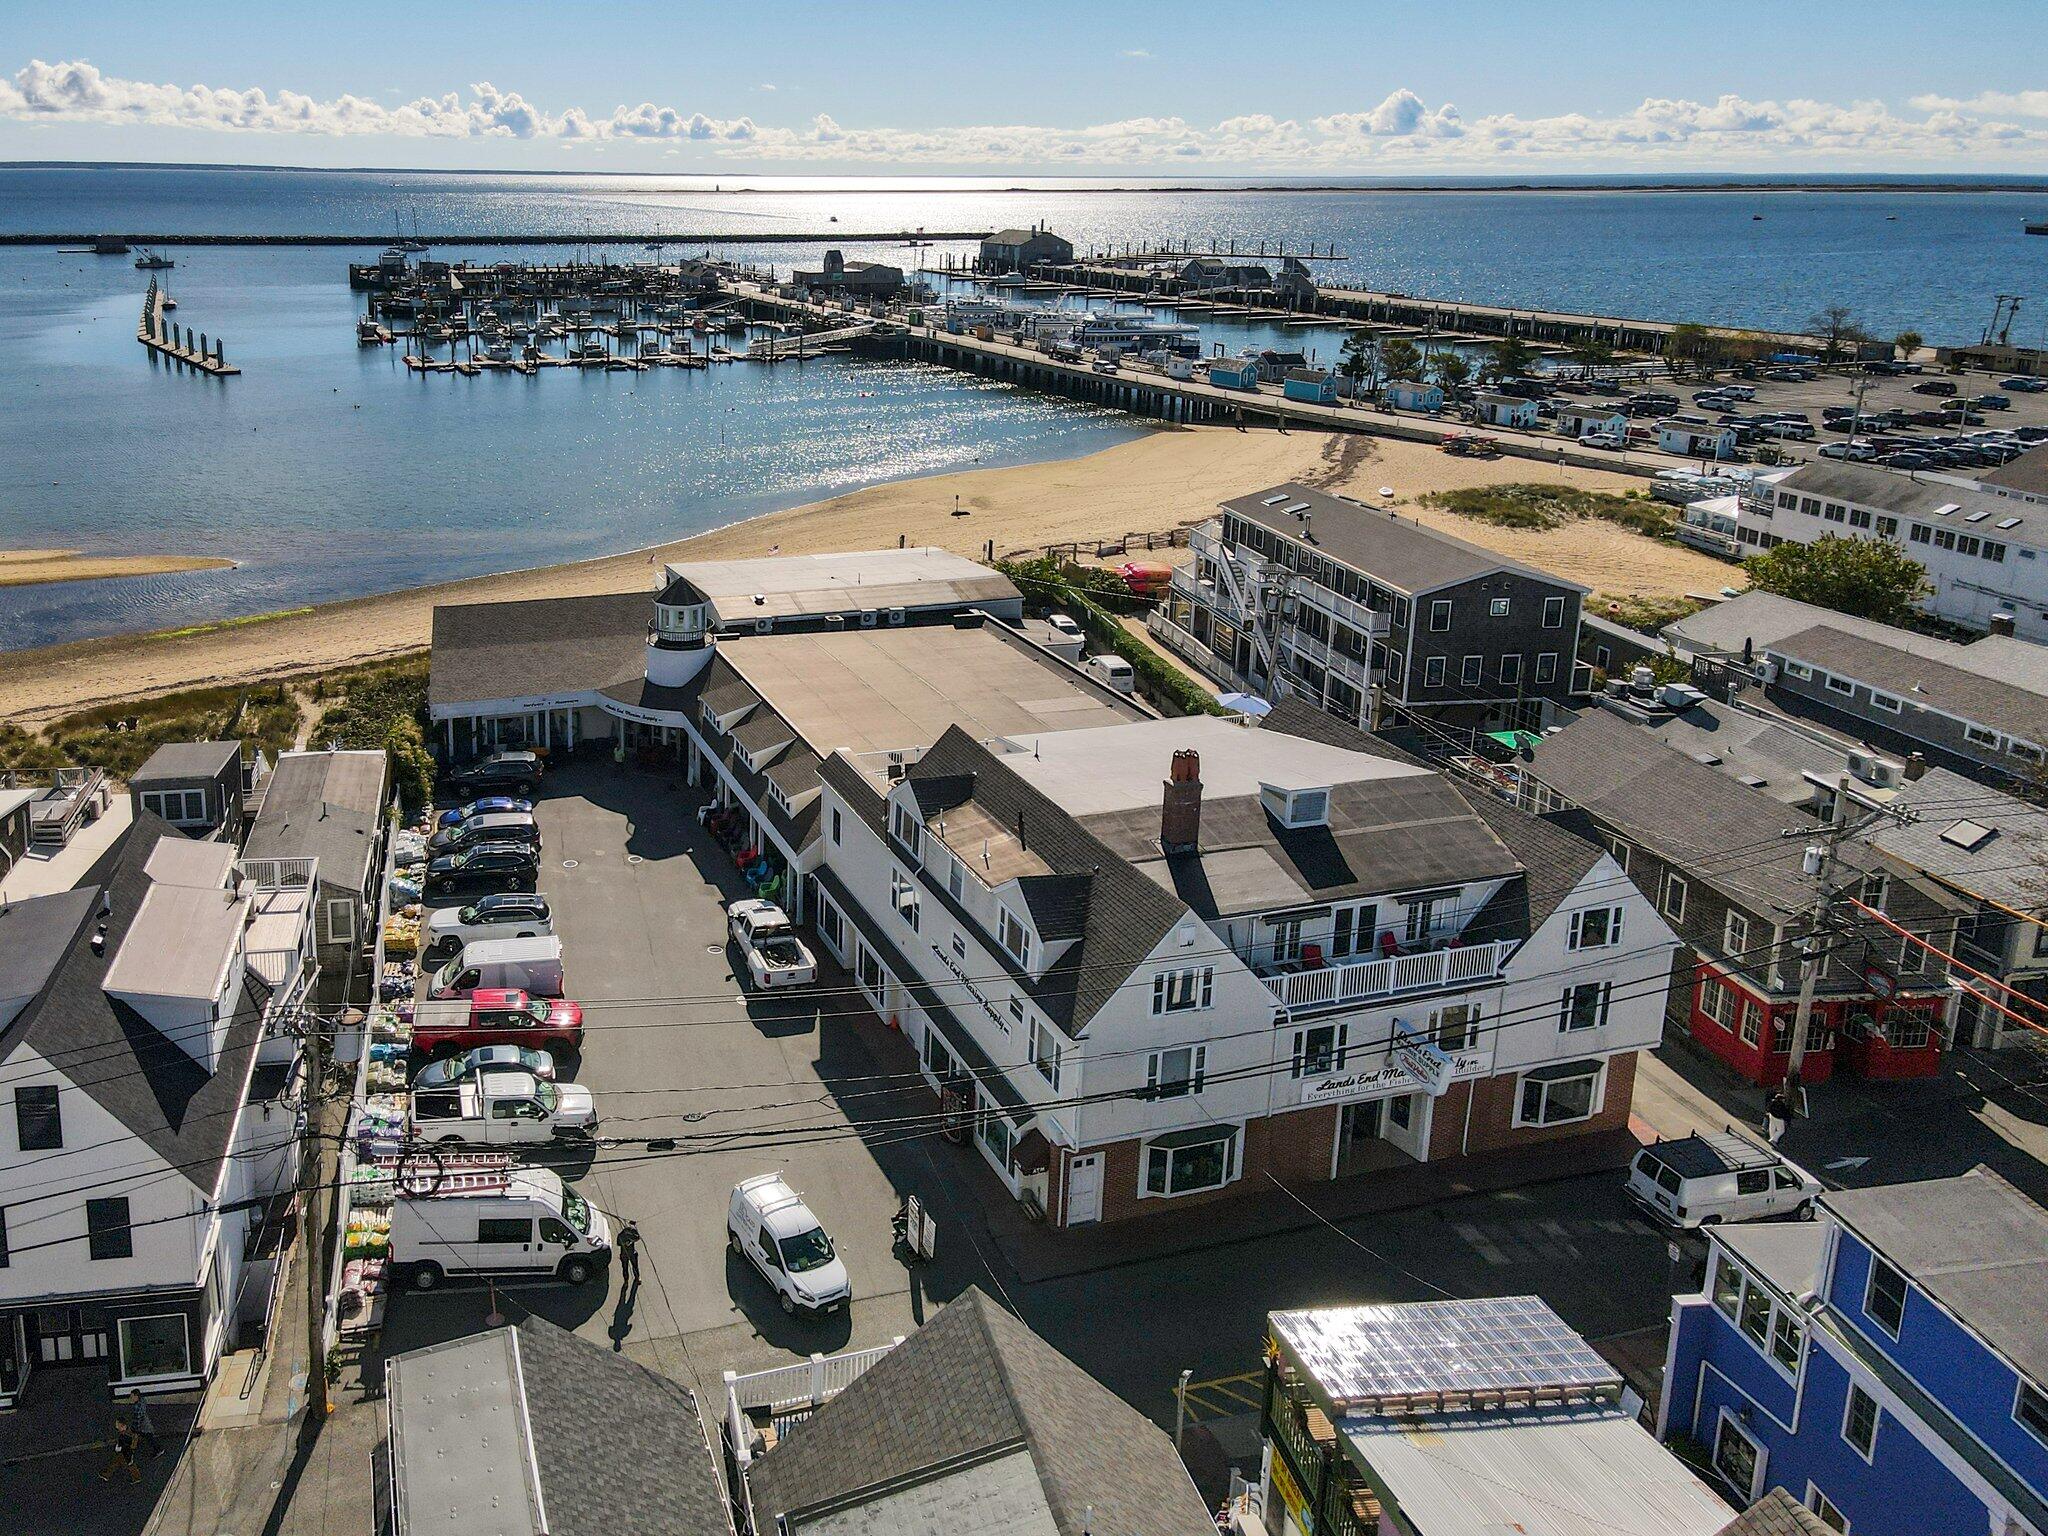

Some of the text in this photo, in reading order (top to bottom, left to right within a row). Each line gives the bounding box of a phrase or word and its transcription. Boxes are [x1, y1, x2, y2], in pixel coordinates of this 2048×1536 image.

[932, 944, 949, 967] Lands
[949, 961, 961, 979] End
[983, 999, 1004, 1030] Supply
[1422, 1049, 1442, 1070] End
[1307, 1087, 1355, 1100] Everything
[1372, 1082, 1386, 1090] the
[1316, 1076, 1355, 1091] Lands
[1357, 1070, 1381, 1084] End
